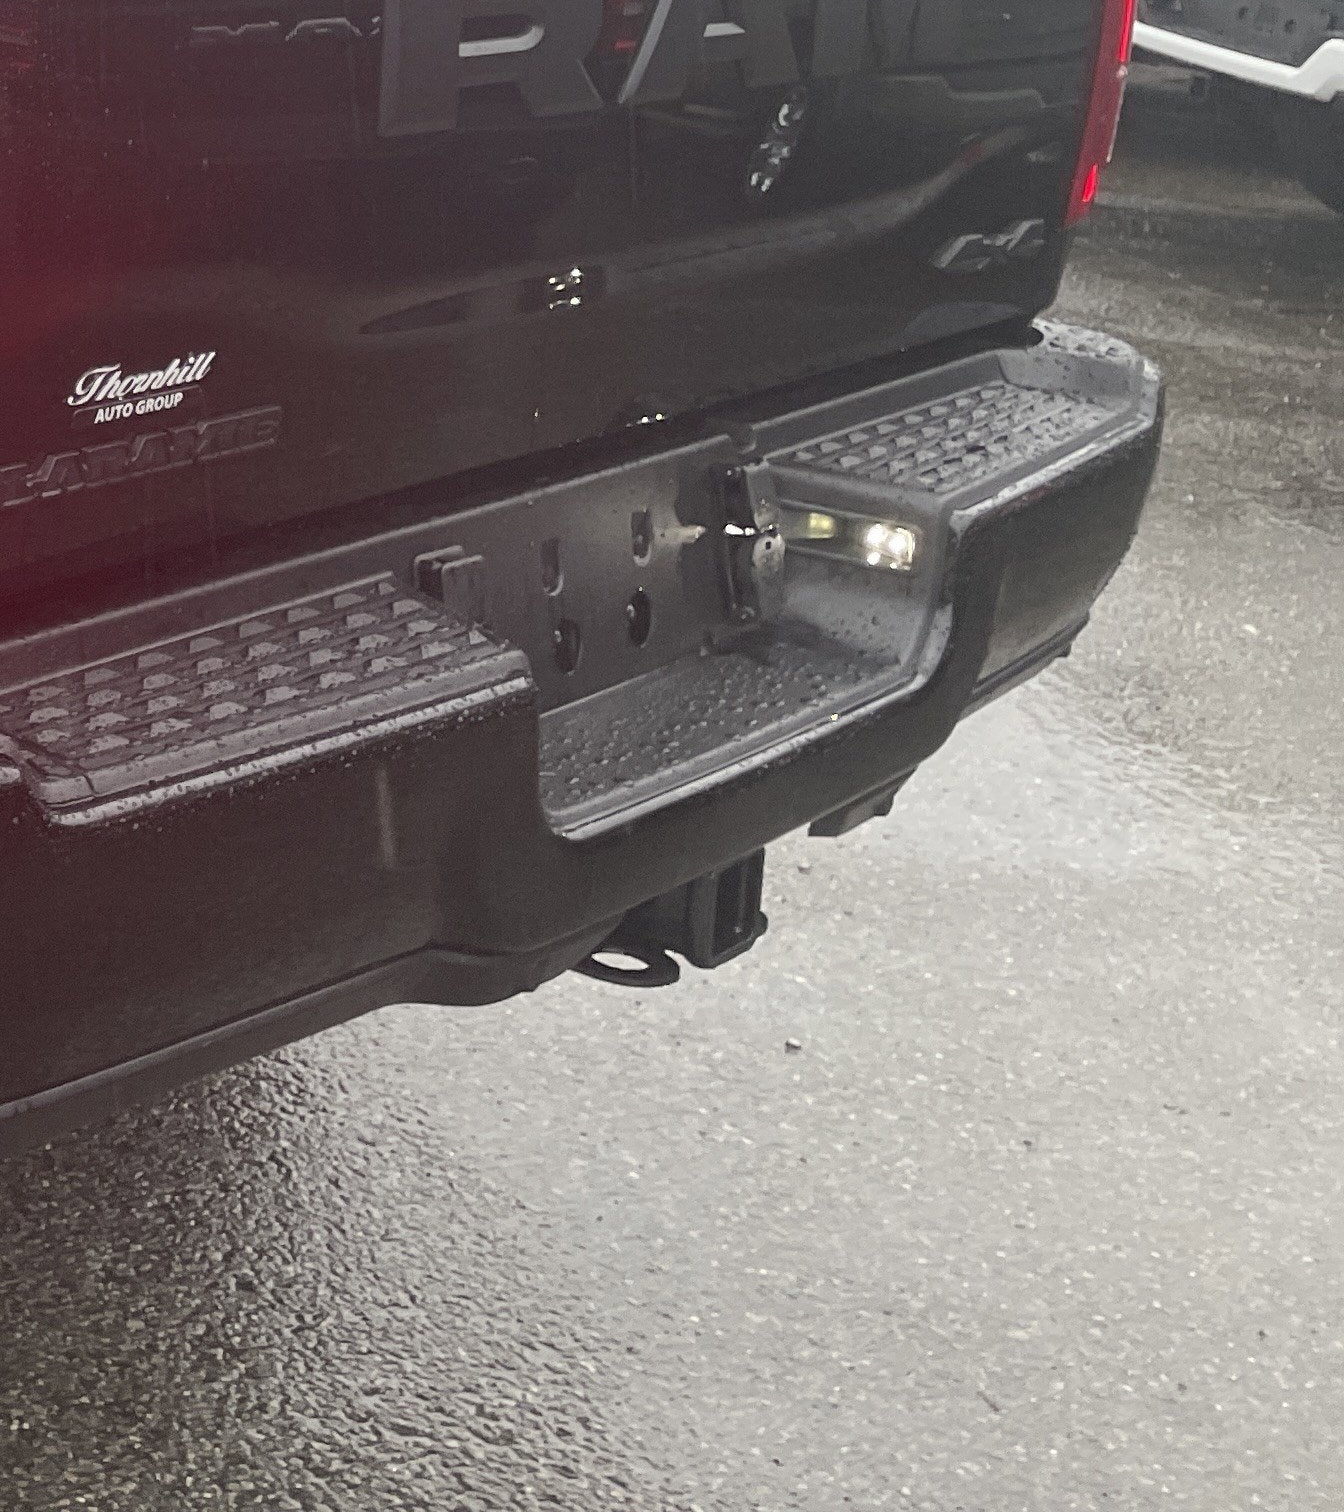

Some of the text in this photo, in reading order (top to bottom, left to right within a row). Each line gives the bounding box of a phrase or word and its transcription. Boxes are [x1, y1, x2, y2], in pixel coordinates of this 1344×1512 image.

[67, 351, 216, 407] Thornhill
[93, 392, 184, 424] AUTO GROUP
